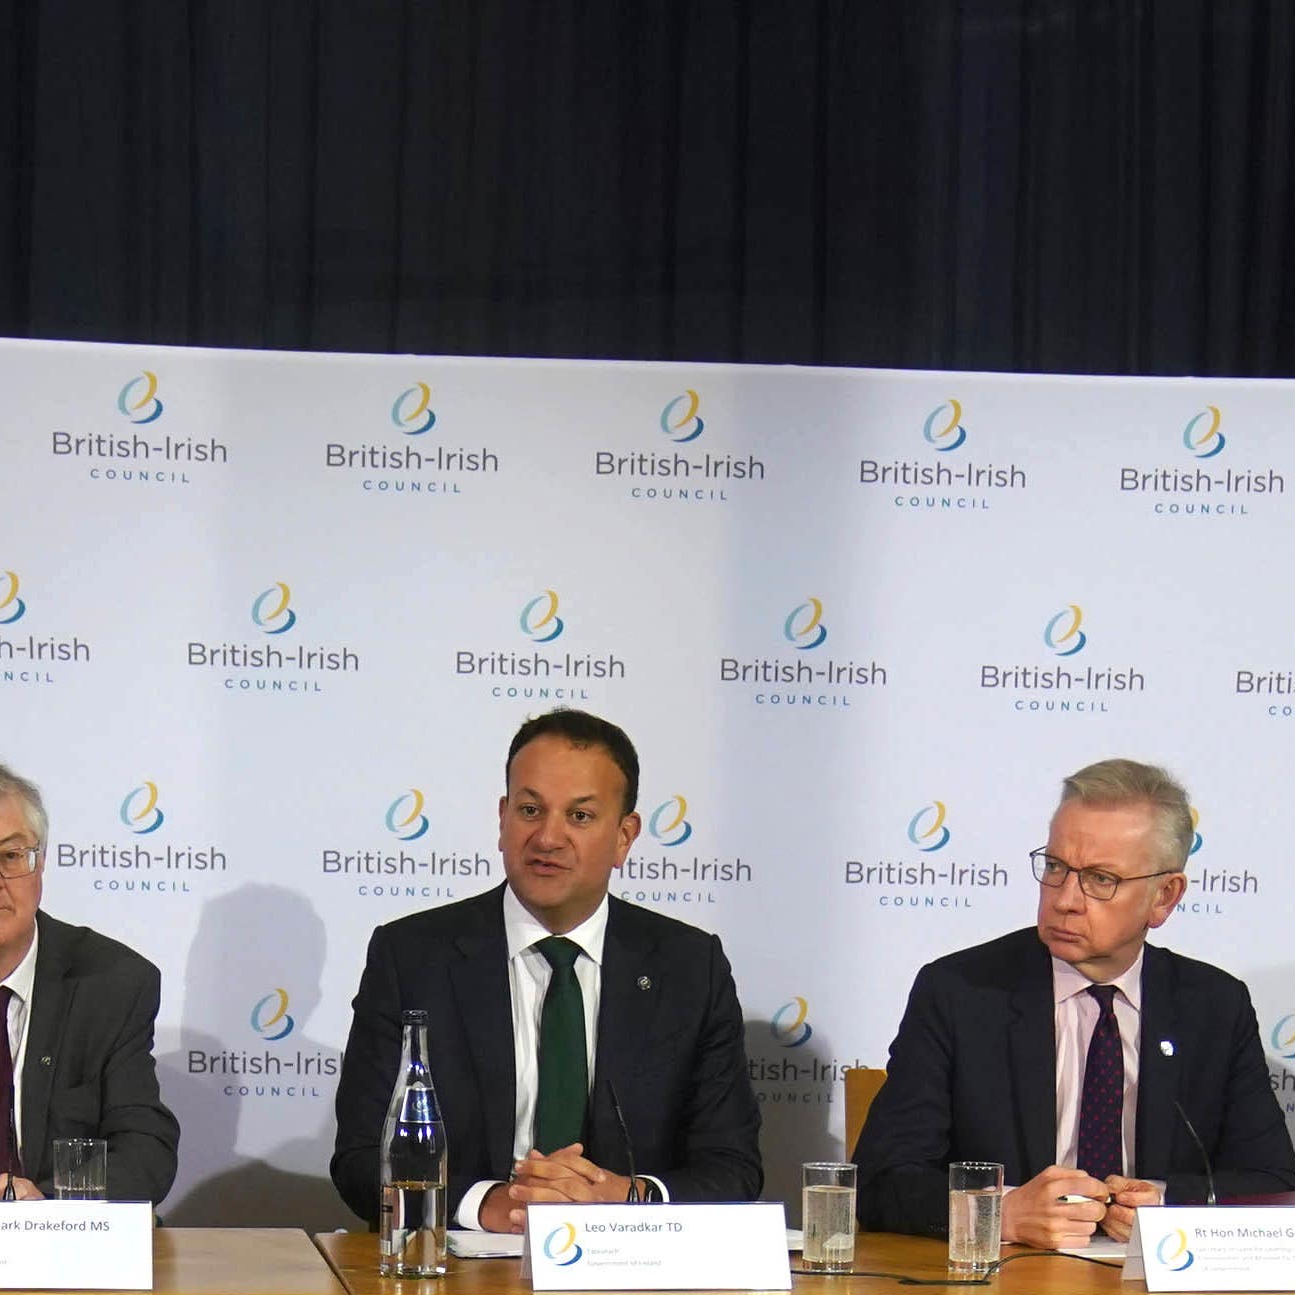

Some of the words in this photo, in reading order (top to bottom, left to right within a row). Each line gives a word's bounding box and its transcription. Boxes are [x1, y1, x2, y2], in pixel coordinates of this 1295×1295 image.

[51, 431, 228, 464] British-Irish
[325, 443, 500, 473] British-Irish
[595, 451, 766, 480] British-Irish
[89, 468, 191, 484] COUNCIL
[859, 459, 1026, 488] British-Irish
[1119, 467, 1285, 494] British-Irish
[362, 479, 461, 493] COUNCIL
[631, 487, 728, 501] COUNCIL
[894, 495, 989, 510] COUNCIL
[1154, 502, 1249, 515] COUNCIL
[187, 642, 359, 671] British-Irish
[455, 650, 626, 679] British-Irish
[719, 657, 888, 687] British-Irish
[980, 665, 1146, 693] British-Irish
[224, 678, 322, 692] COUNCIL
[492, 686, 589, 700] COUNCIL
[755, 693, 851, 706] COUNCIL
[1015, 699, 1109, 713] COUNCIL
[56, 844, 227, 872] British-Irish
[321, 850, 491, 877] British-Irish
[844, 860, 1009, 888] British-Irish
[93, 880, 191, 893] COUNCIL
[358, 886, 455, 898] COUNCIL
[621, 891, 716, 903] COUNCIL
[878, 896, 973, 908] COUNCIL
[1176, 903, 1223, 914] NCIL
[224, 1085, 320, 1097] COUNCIL
[756, 1092, 834, 1104] OUNCIL
[24, 1219, 86, 1232] Drakeford
[90, 1221, 110, 1232] MS
[585, 1222, 606, 1233] Leo
[609, 1222, 664, 1233] Varadkar
[666, 1222, 683, 1233] TD
[1195, 1228, 1207, 1238] Rt
[1210, 1228, 1234, 1239] Hon
[1237, 1227, 1283, 1239] Michael
